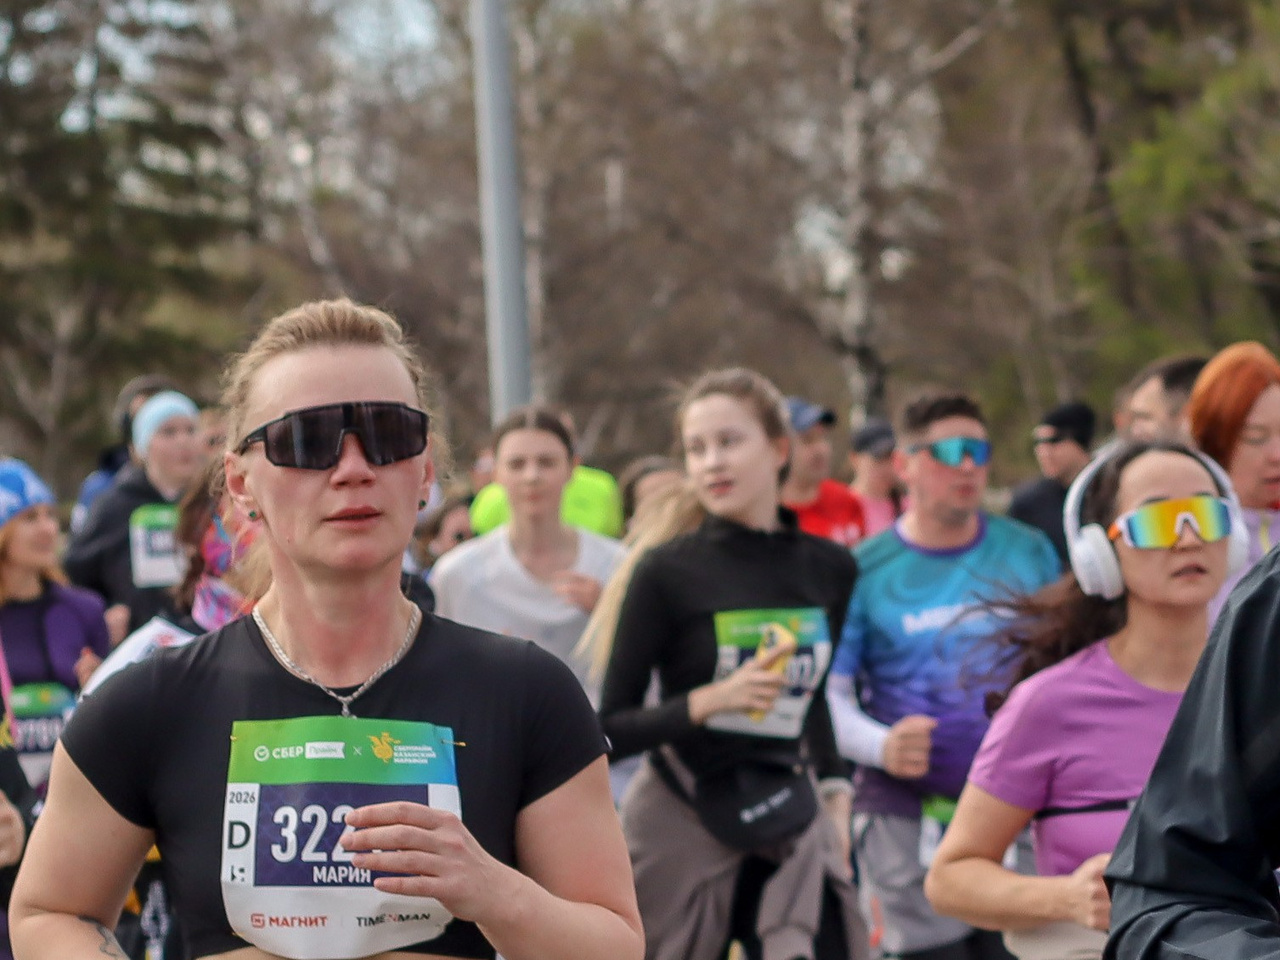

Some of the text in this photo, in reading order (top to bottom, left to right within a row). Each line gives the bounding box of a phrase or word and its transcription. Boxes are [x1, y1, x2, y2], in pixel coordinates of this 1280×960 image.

[271, 747, 304, 760] СБЕР
[229, 791, 256, 804] 2026
[227, 820, 252, 850] D
[312, 865, 372, 885] МАРИЯ
[268, 914, 328, 928] МАГНИТ
